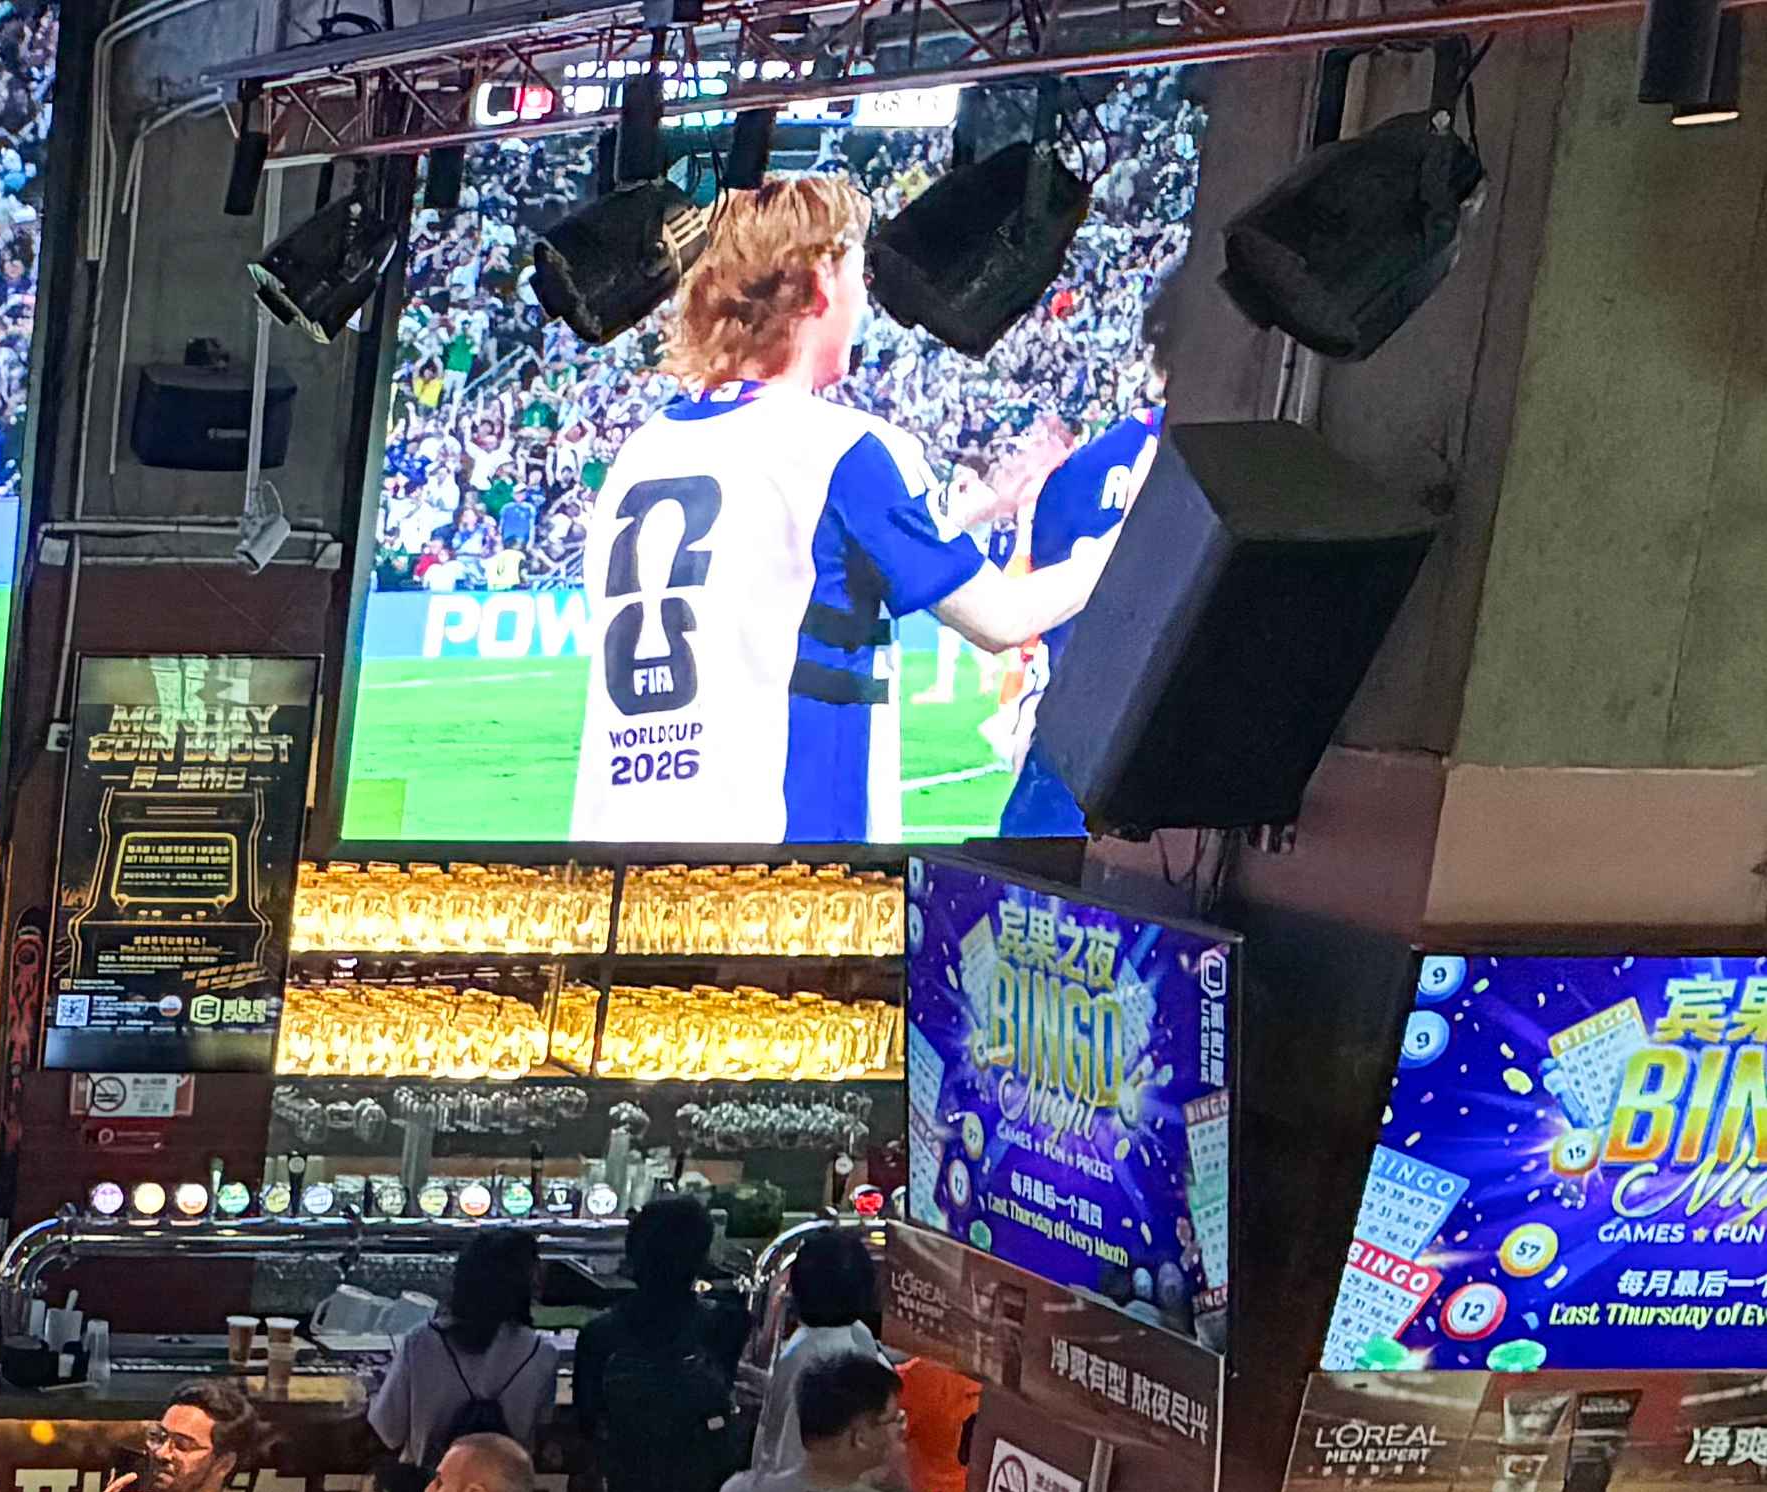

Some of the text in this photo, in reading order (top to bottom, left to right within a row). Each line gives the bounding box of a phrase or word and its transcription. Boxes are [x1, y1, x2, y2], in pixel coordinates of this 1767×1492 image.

[108, 704, 279, 733] MONDAY
[88, 732, 177, 762] COIN
[609, 724, 667, 749] WORLD
[610, 748, 701, 786] 2026
[997, 900, 1122, 992] 宾果之夜
[1432, 965, 1447, 984] 9
[988, 959, 1125, 1108] BINGO
[1415, 1030, 1431, 1050] 9
[999, 1068, 1101, 1145] Night
[996, 1123, 1033, 1151] GAMES
[1076, 1153, 1113, 1184] PRIZES
[1567, 1143, 1587, 1161] 15
[1374, 1153, 1456, 1198] BINGO
[1010, 1202, 1054, 1238] Thursday
[1064, 1224, 1095, 1257] Every
[1095, 1236, 1128, 1267] Month
[1598, 1223, 1766, 1243] GAMES FUN
[1515, 1241, 1541, 1259] 57
[1347, 1241, 1429, 1293] BINGO
[1459, 1302, 1486, 1321] 12
[1549, 1302, 1601, 1326] Last
[1606, 1302, 1713, 1331] Thursday
[1715, 1302, 1743, 1326] of
[1051, 1336, 1209, 1445] 净爽有型 熬夜尽兴
[1315, 1418, 1448, 1449] L'ORÉAL
[1325, 1446, 1431, 1464] MEN EXPERT
